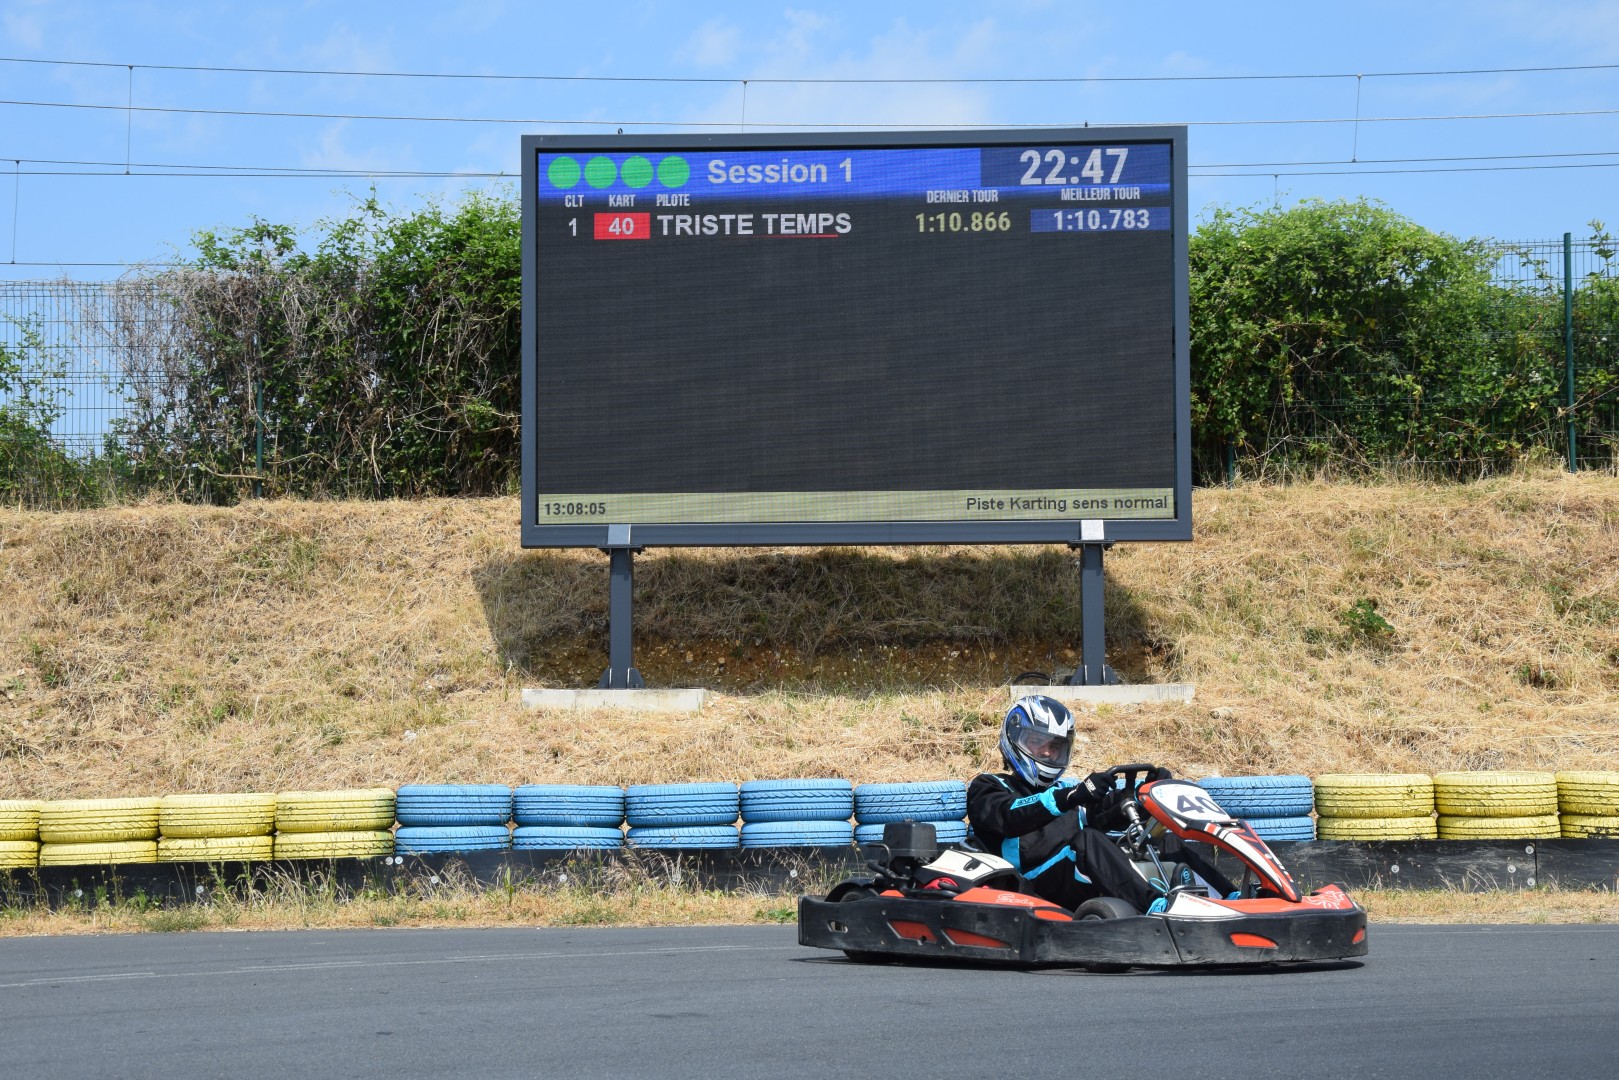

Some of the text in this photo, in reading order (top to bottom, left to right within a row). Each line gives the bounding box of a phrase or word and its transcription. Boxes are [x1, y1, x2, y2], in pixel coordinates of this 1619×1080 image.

[707, 157, 853, 184] Session 1
[1019, 148, 1129, 185] 22:47
[564, 194, 585, 208] CLT
[608, 194, 636, 208] KART
[656, 193, 691, 207] PILOTE
[926, 189, 999, 204] DERNIER TOUR
[1060, 187, 1141, 201] MEILLEUR TOUR
[568, 218, 578, 236] 1
[608, 217, 635, 235] 40
[656, 213, 852, 236] TRISTE TEMPS
[915, 211, 1011, 233] 1:10.866
[1053, 209, 1150, 231] 1:10.783
[544, 502, 606, 516] 13:08:05
[966, 496, 1168, 512] Piste Karting sens normal
[1176, 794, 1227, 816] 40
